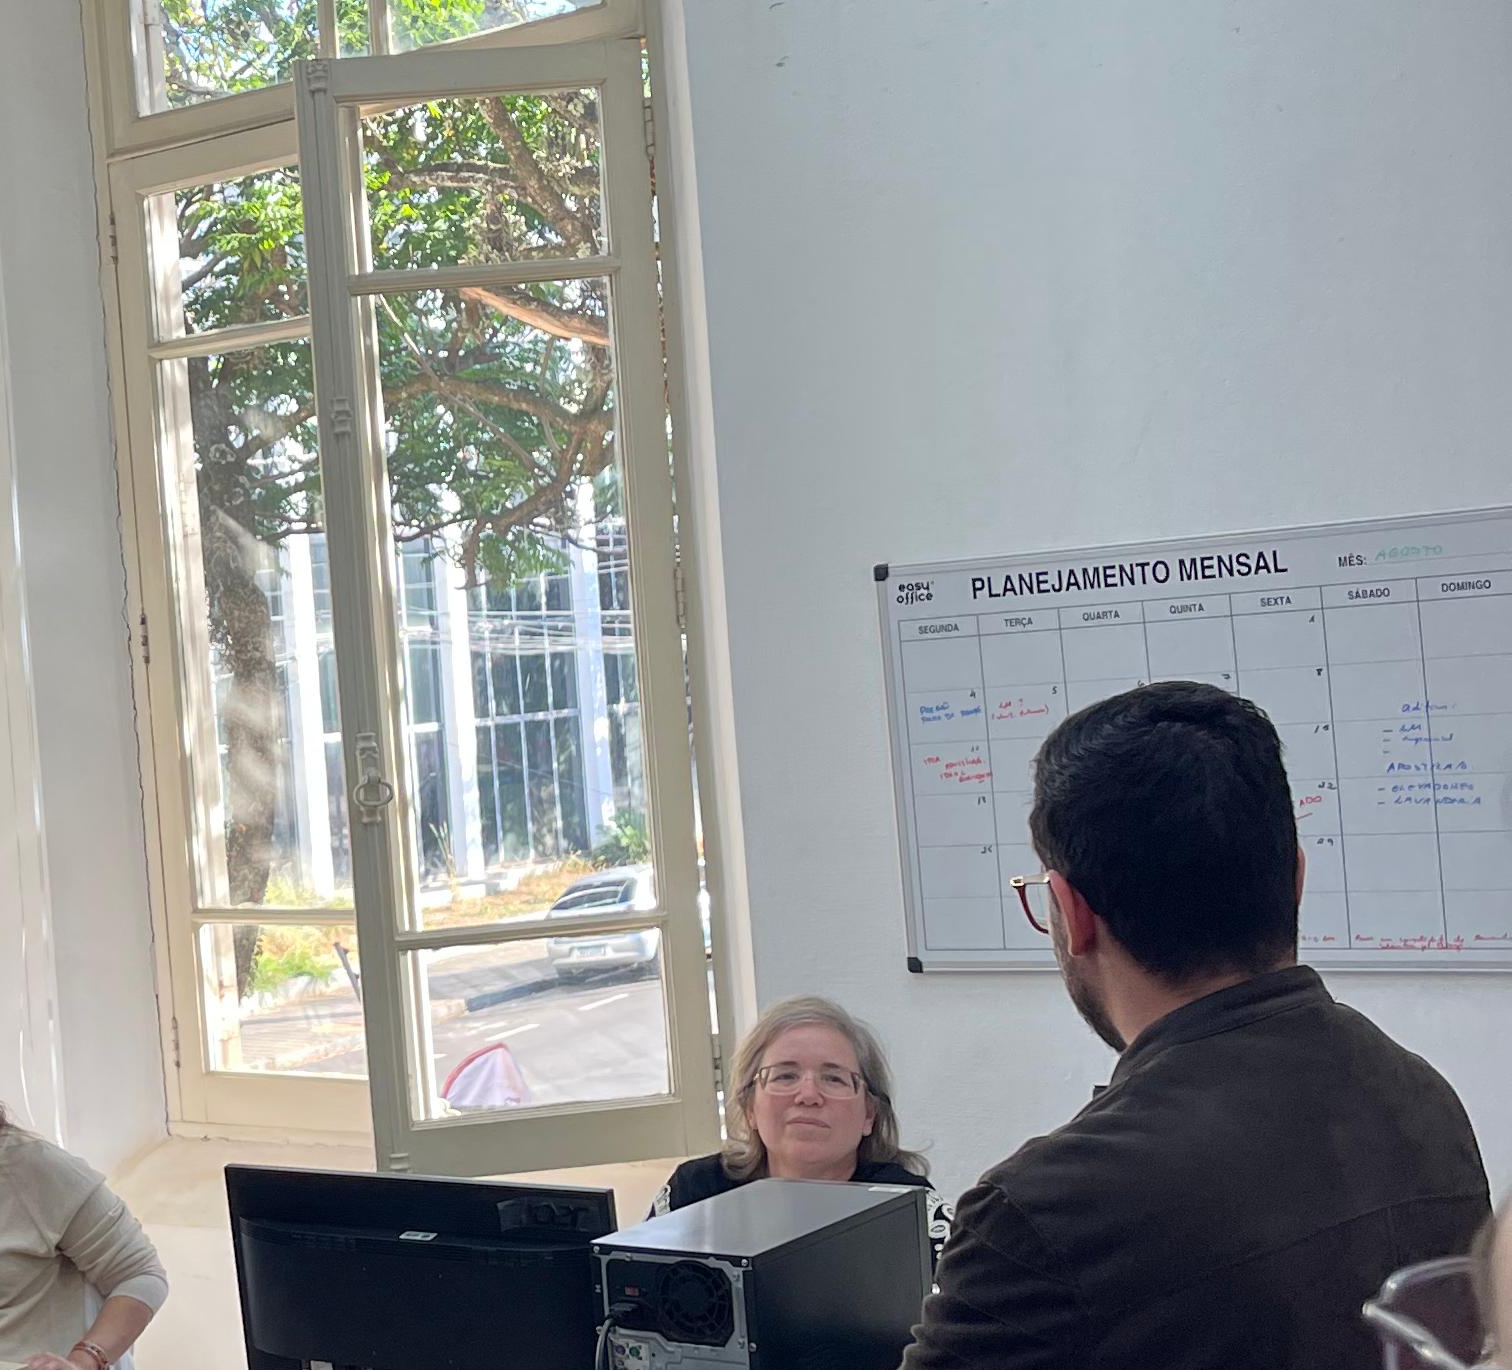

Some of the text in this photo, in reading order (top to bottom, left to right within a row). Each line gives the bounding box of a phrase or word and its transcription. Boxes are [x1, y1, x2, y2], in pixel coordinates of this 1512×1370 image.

[1338, 553, 1367, 568] MÊS:
[971, 550, 1288, 599] PLANEJAMENTO MENSAL
[898, 581, 930, 592] easy
[1441, 579, 1492, 593] DOMINGO
[896, 592, 934, 605] office
[1347, 587, 1391, 600] SÁBADO
[1169, 602, 1205, 614] QUINTA
[1260, 595, 1292, 608] SEXTA
[1082, 609, 1120, 622] QUARTA
[918, 623, 960, 635] SEGUNDA
[1004, 617, 1033, 629] TERÇA
